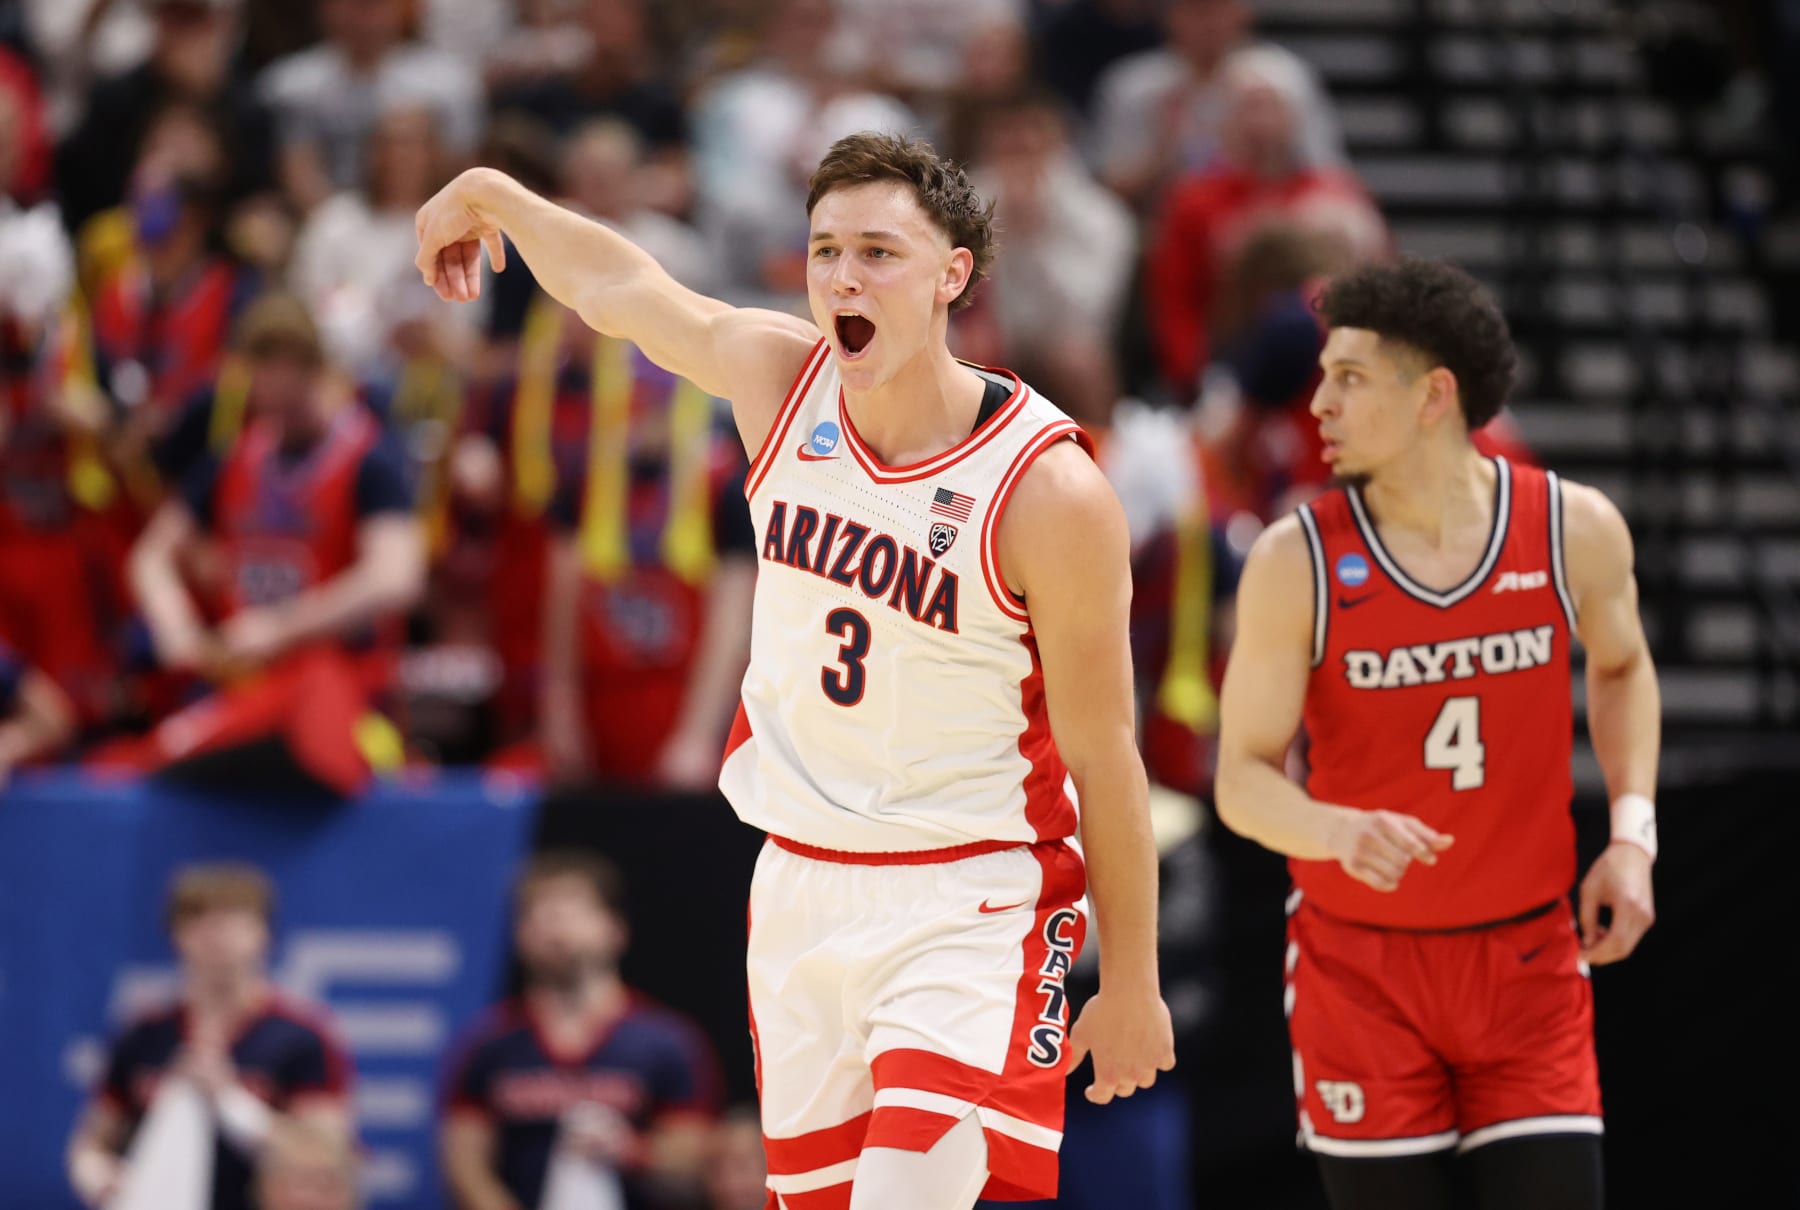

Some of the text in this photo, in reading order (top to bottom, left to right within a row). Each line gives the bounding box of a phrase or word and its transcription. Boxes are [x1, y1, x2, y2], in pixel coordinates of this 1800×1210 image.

[763, 501, 959, 634] ARIZONA
[821, 607, 872, 707] 3
[1344, 625, 1554, 689] DAYTON
[1424, 695, 1485, 792] 4
[1027, 908, 1078, 1068] CATS
